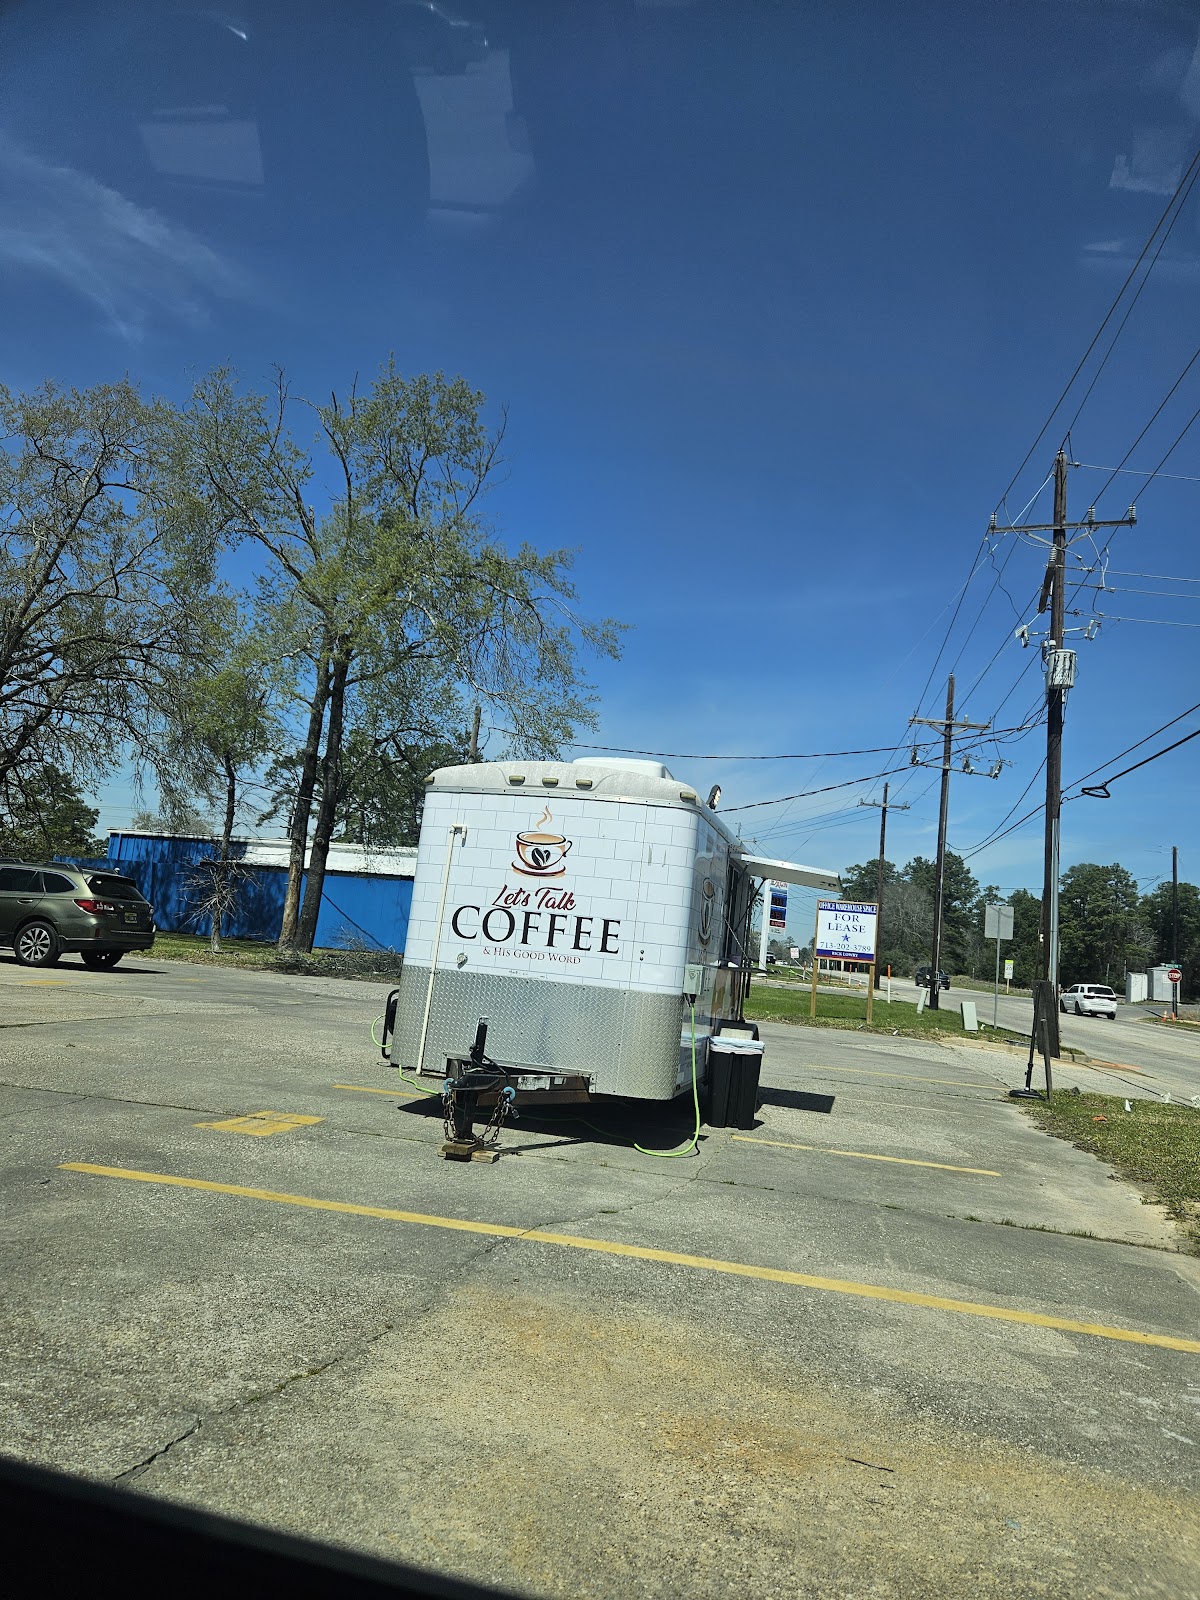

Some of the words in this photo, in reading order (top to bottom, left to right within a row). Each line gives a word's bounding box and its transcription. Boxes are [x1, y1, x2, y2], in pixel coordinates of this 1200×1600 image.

[492, 884, 531, 909] Let's
[535, 887, 577, 911] Talk
[834, 913, 859, 922] FOR
[451, 905, 621, 954] COFFEE
[828, 922, 866, 933] LEASE
[820, 941, 871, 952] 713-202-3789
[482, 946, 491, 955] &
[494, 947, 511, 957] HIS
[513, 949, 545, 961] GOOD
[548, 953, 581, 965] WORD
